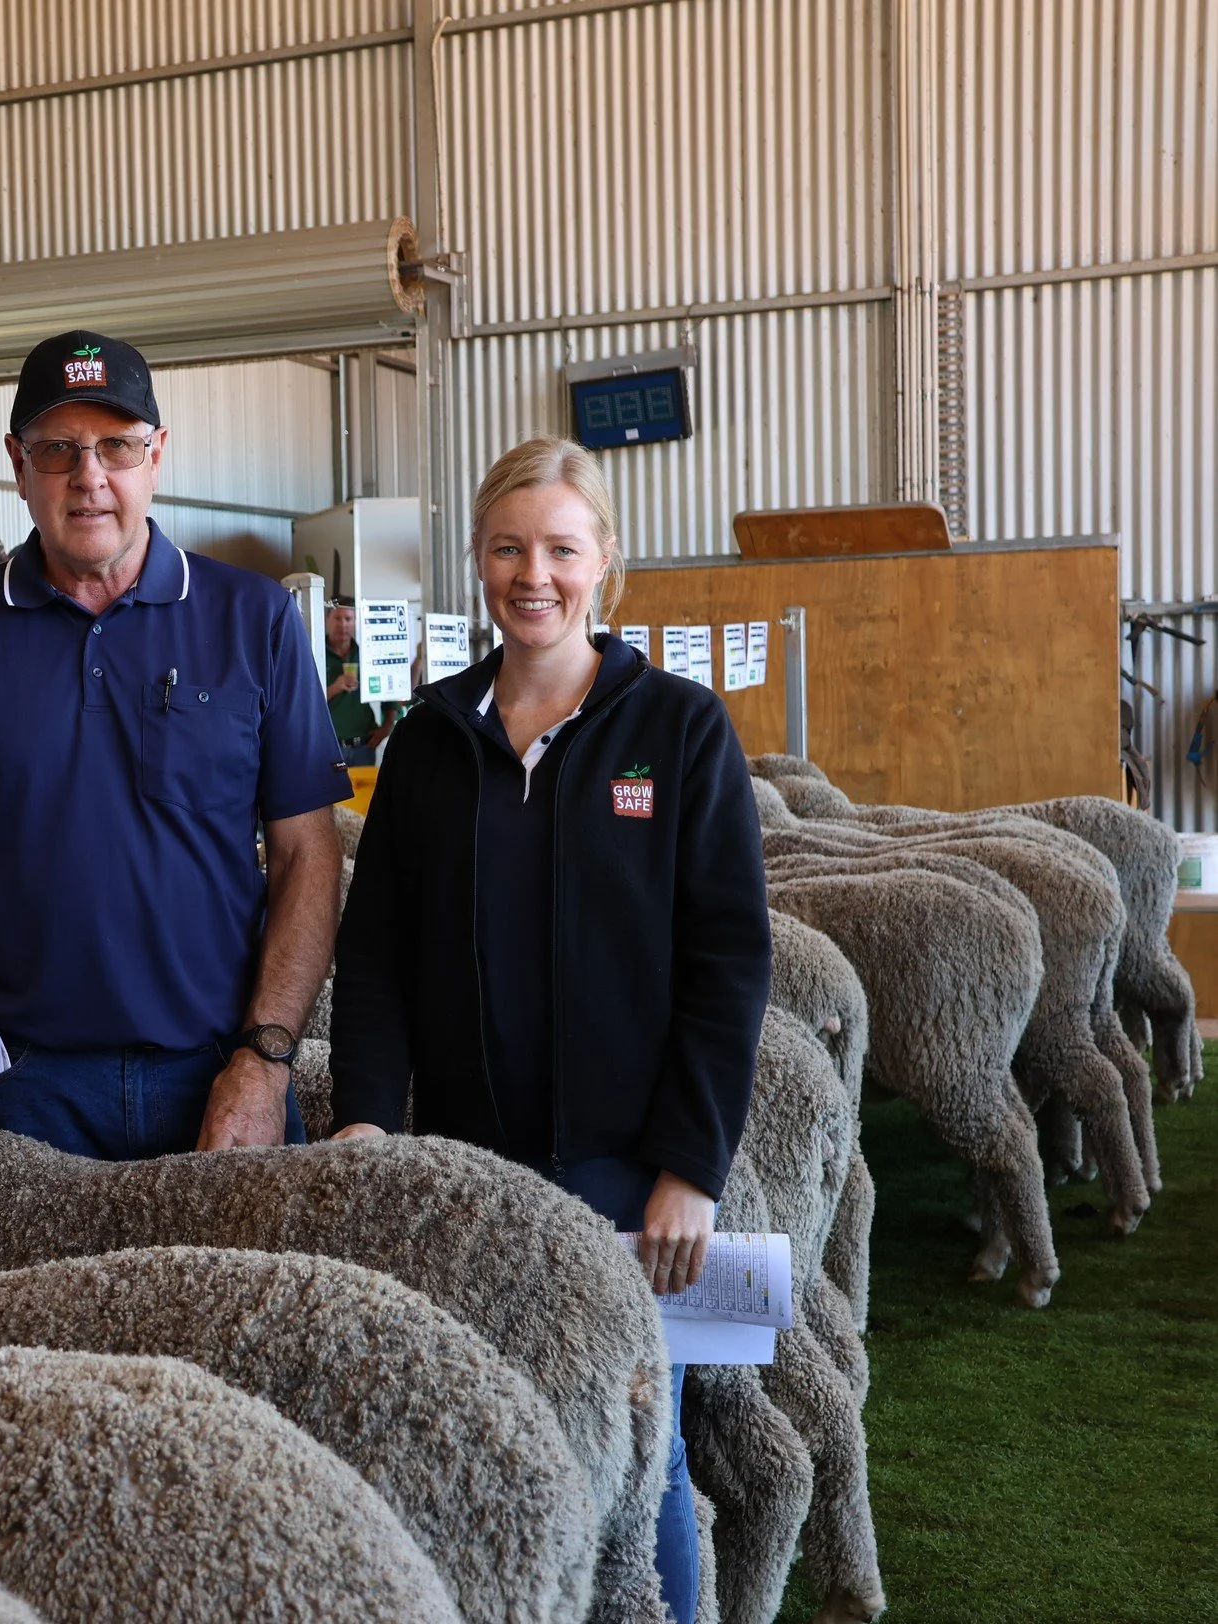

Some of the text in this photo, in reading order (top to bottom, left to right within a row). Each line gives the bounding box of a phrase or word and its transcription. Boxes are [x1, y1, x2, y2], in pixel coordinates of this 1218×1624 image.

[65, 361, 103, 373] GROW
[68, 371, 102, 383] SAFE
[613, 785, 653, 799] GROW
[617, 797, 651, 811] SAFE
